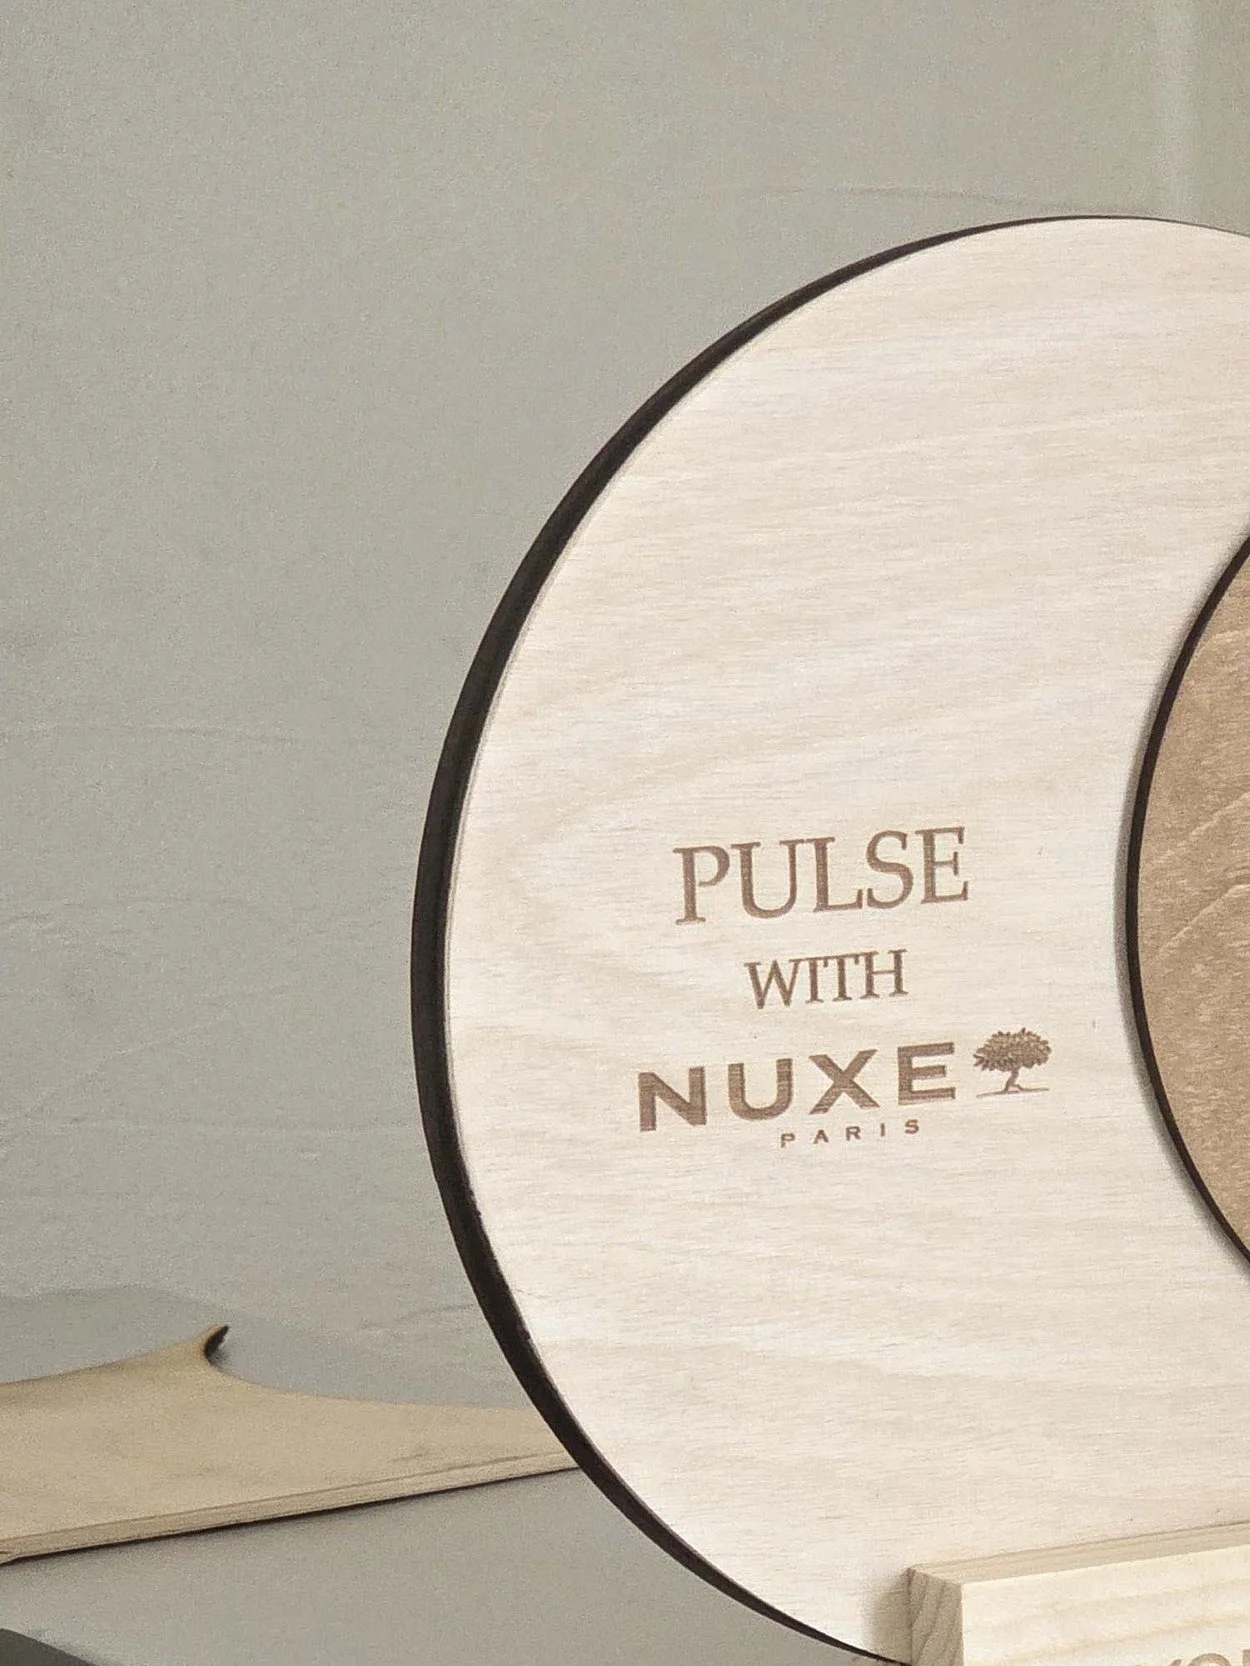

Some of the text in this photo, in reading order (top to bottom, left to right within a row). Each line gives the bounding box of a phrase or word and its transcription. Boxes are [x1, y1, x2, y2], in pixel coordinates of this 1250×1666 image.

[673, 826, 969, 925] PULSE
[744, 949, 909, 1010] WITH
[638, 1042, 957, 1132] NUXE
[780, 1119, 921, 1149] PARIS
